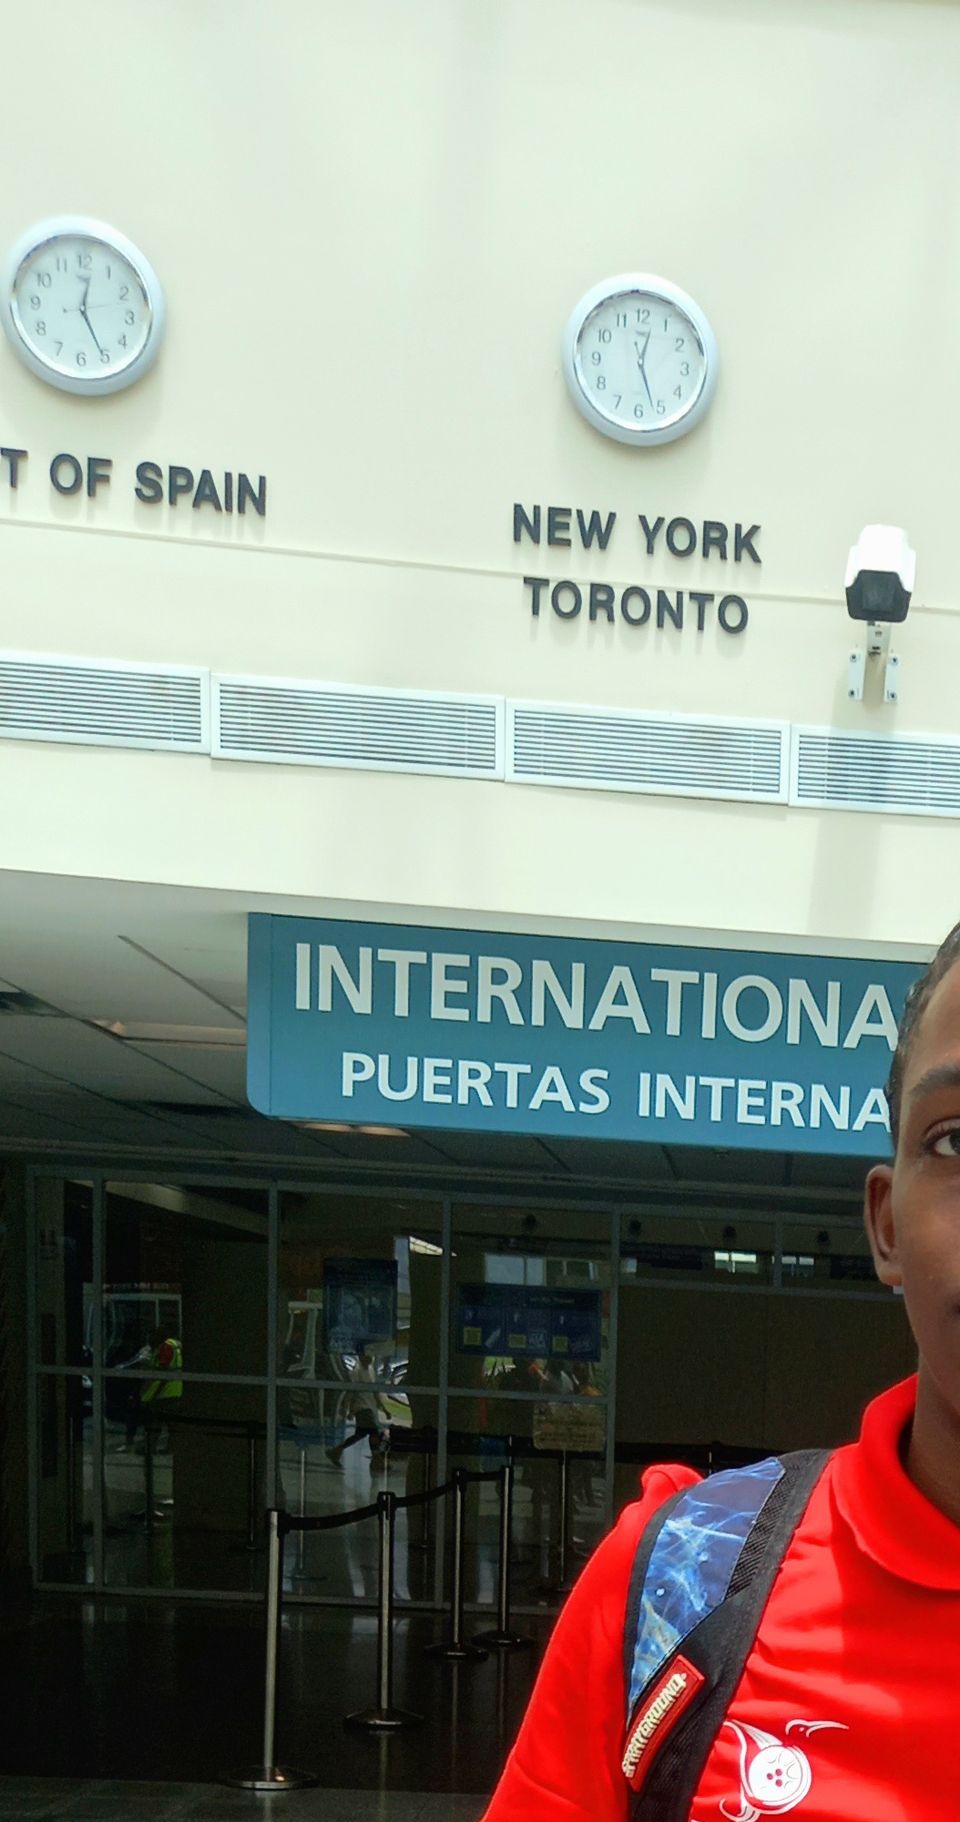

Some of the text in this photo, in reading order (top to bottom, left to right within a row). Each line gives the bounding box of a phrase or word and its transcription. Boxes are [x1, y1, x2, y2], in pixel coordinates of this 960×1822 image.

[56, 257, 67, 272] 11
[77, 254, 93, 270] 12
[37, 272, 52, 288] 10
[119, 286, 129, 301] 2
[30, 295, 41, 311] 9
[124, 310, 135, 326] 3
[617, 313, 627, 328] 11
[635, 308, 650, 324] 12
[36, 321, 46, 336] 8
[118, 333, 127, 350] 4
[598, 329, 612, 344] 10
[54, 340, 63, 356] 7
[675, 338, 685, 352] 2
[76, 352, 87, 367] 6
[100, 349, 110, 364] 5
[592, 352, 601, 366] 9
[680, 361, 689, 376] 3
[596, 376, 606, 390] 8
[673, 384, 682, 400] 4
[613, 395, 622, 409] 7
[656, 400, 666, 414] 5
[634, 404, 644, 418] 6
[0, 447, 267, 517] T OF SPAIN
[513, 503, 762, 564] NEW YORK
[523, 576, 749, 635] TORONTO
[295, 942, 899, 1052] INTERNATIONA
[341, 1052, 892, 1133] PUERTAS INTERNA
